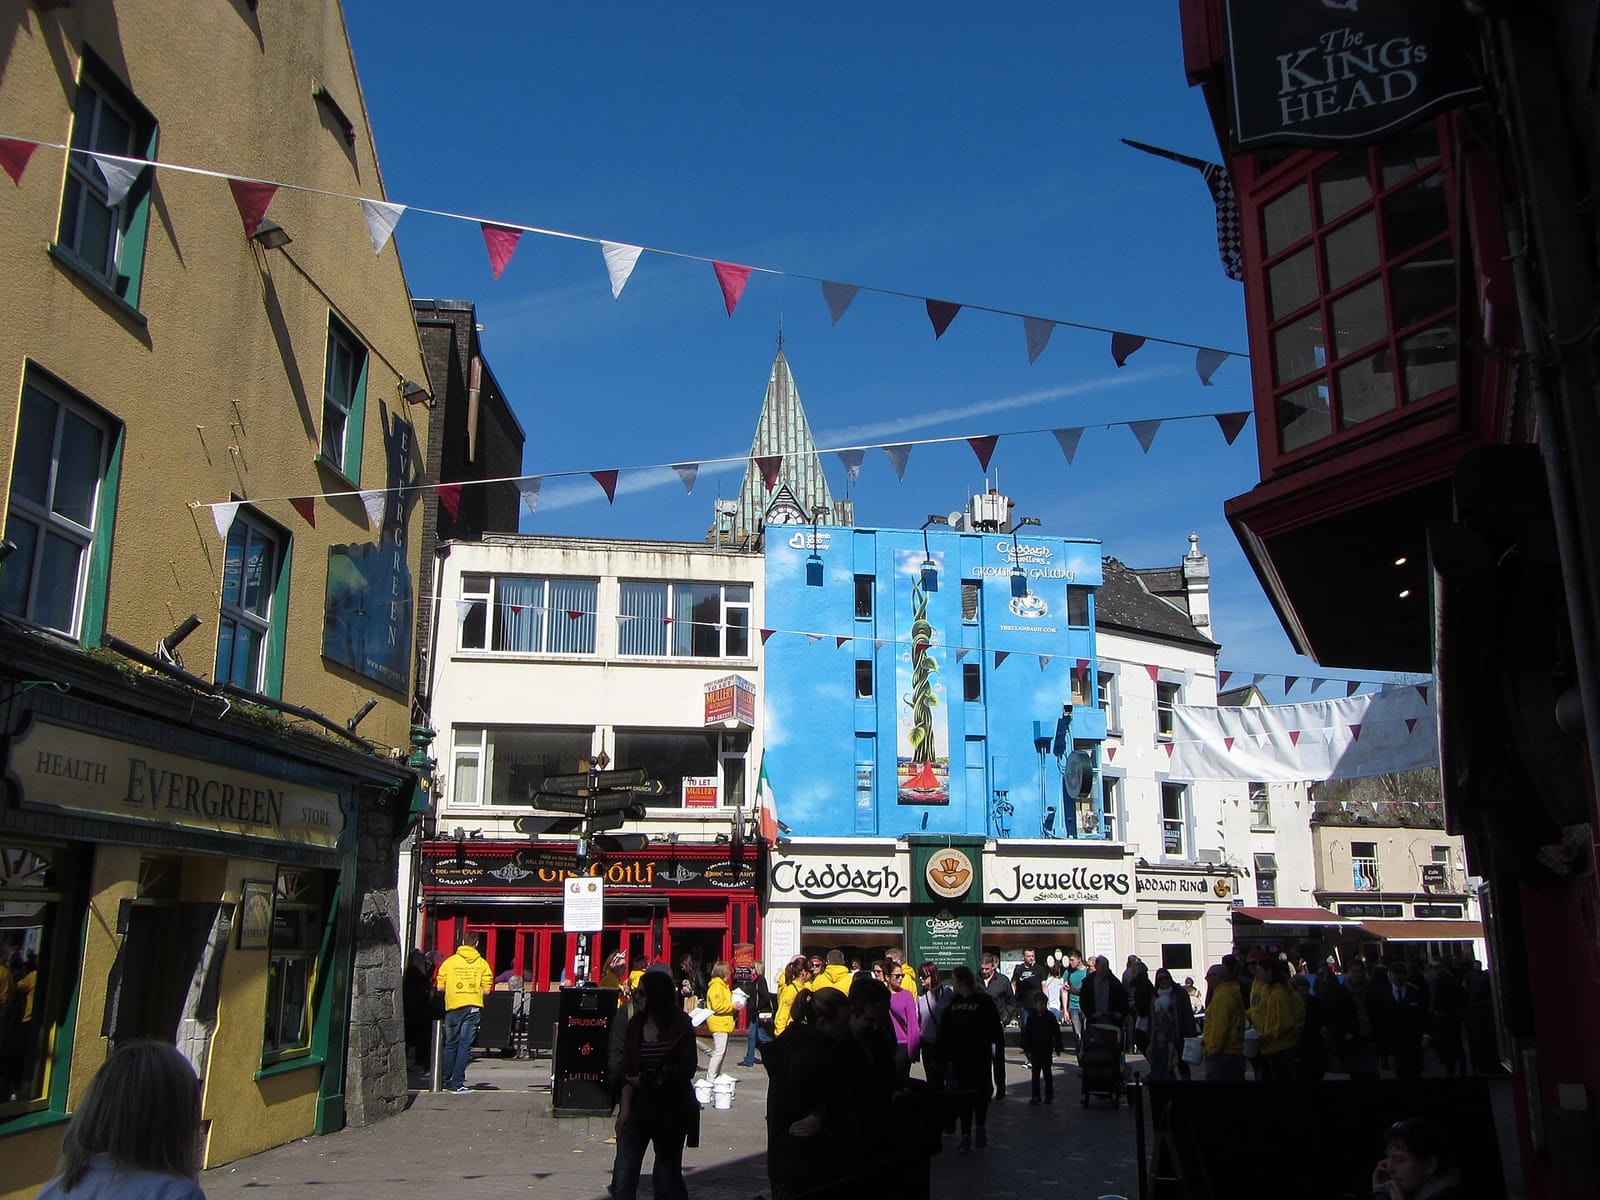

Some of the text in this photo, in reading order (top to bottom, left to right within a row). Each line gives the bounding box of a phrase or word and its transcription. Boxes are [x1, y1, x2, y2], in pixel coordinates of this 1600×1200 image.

[1320, 27, 1364, 53] The
[1277, 68, 1418, 126] HEAD
[386, 430, 409, 648] EVERGREEN
[36, 750, 332, 827] HEALTH EVERGREEN STORE
[771, 860, 907, 899] Claddagh
